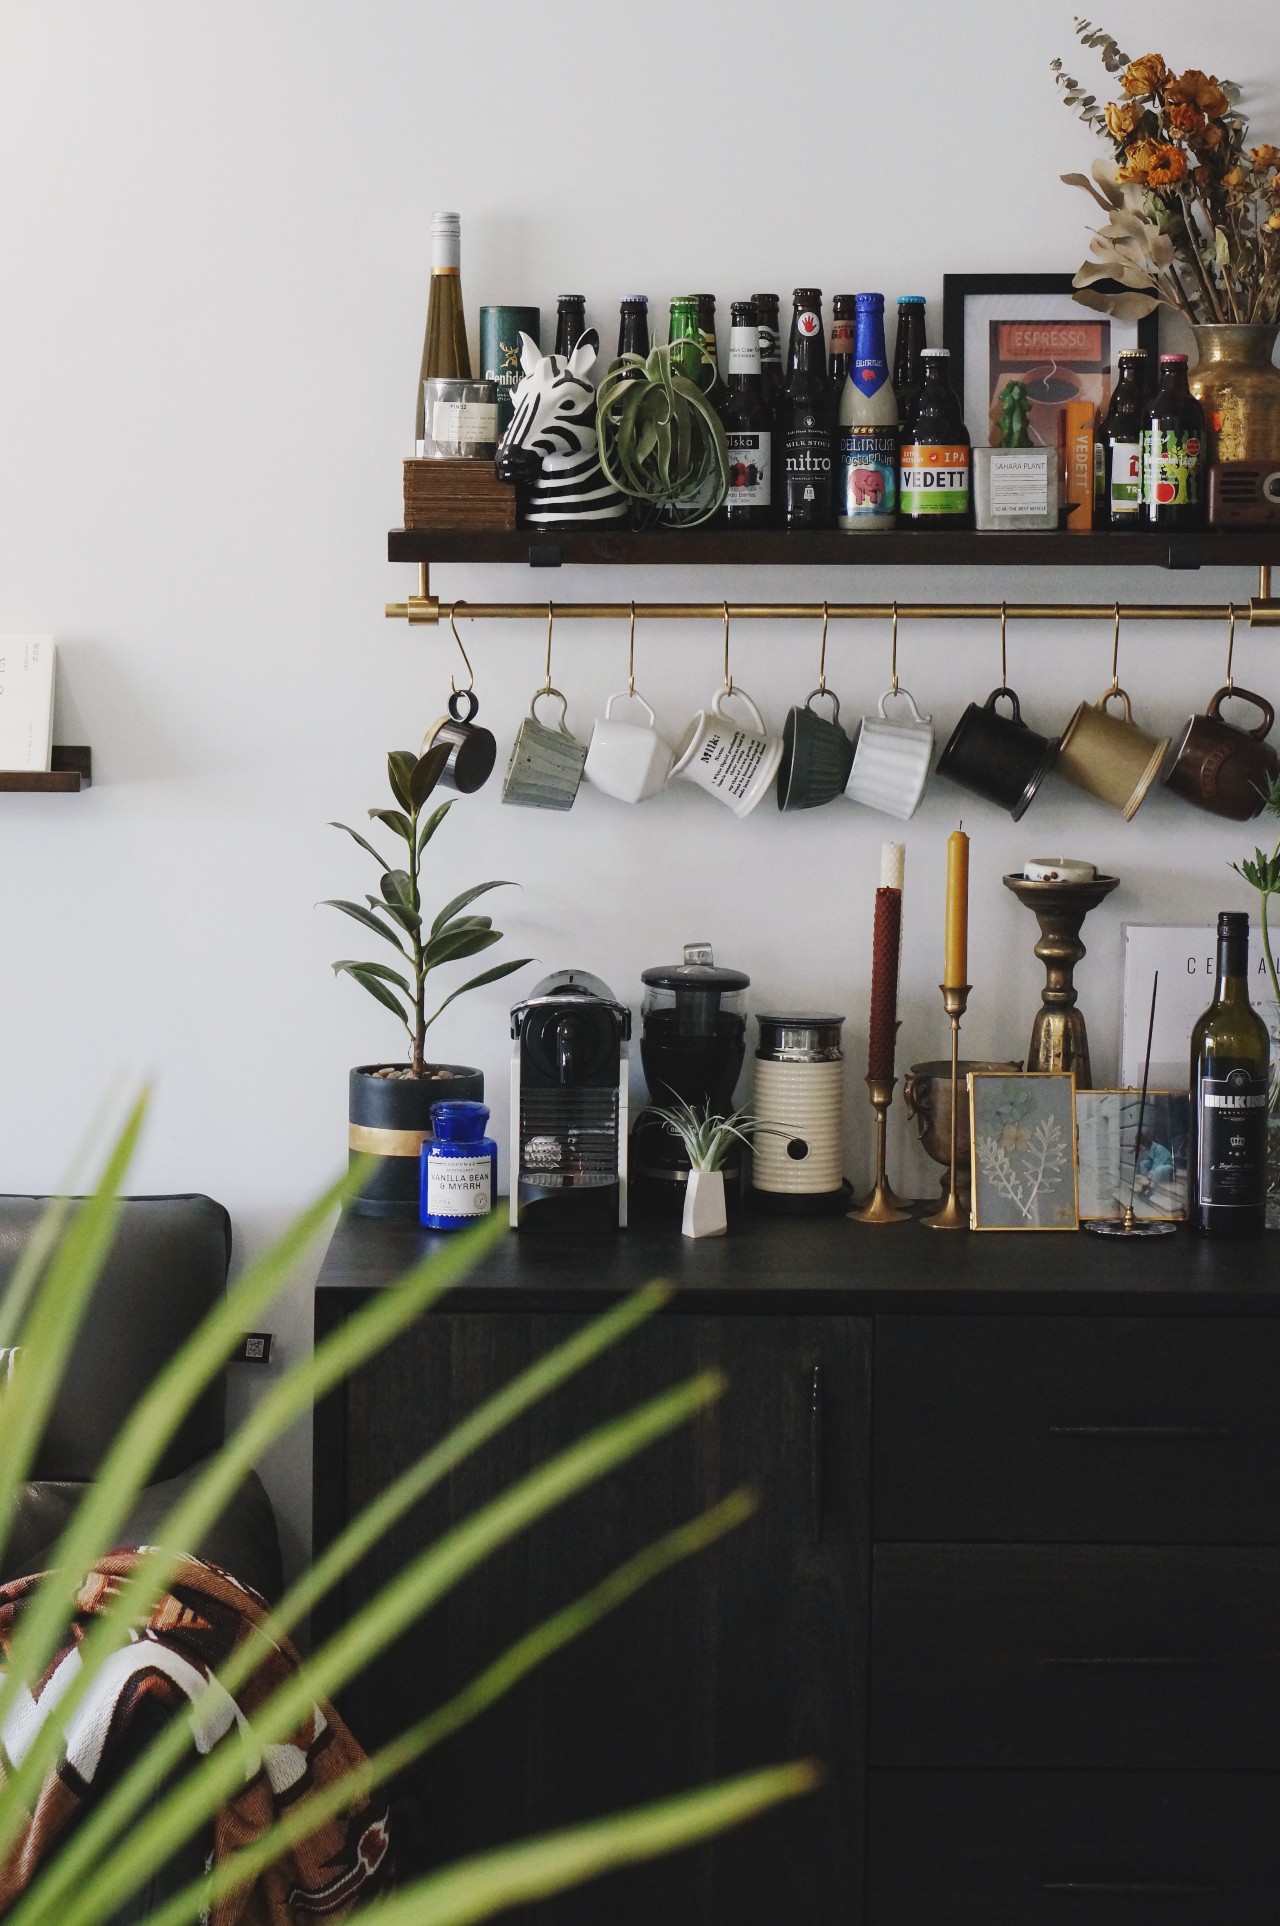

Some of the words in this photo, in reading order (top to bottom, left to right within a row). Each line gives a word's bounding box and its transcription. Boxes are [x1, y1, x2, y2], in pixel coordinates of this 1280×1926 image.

[1014, 331, 1087, 347] ESPRESSO
[786, 440, 806, 448] MILK
[807, 440, 830, 448] STOUT
[841, 438, 895, 451] DELIRIUM
[786, 450, 831, 471] nitro
[994, 462, 1022, 470] SAHARA
[1023, 462, 1046, 470] PLANT
[1076, 435, 1089, 489] VEDETT
[903, 471, 965, 488] VEDETT
[700, 734, 720, 763] Milk:
[1187, 957, 1280, 975] CEAL
[431, 1174, 467, 1182] VANILLA
[469, 1173, 489, 1182] BEAN
[448, 1182, 481, 1190] MYRRH
